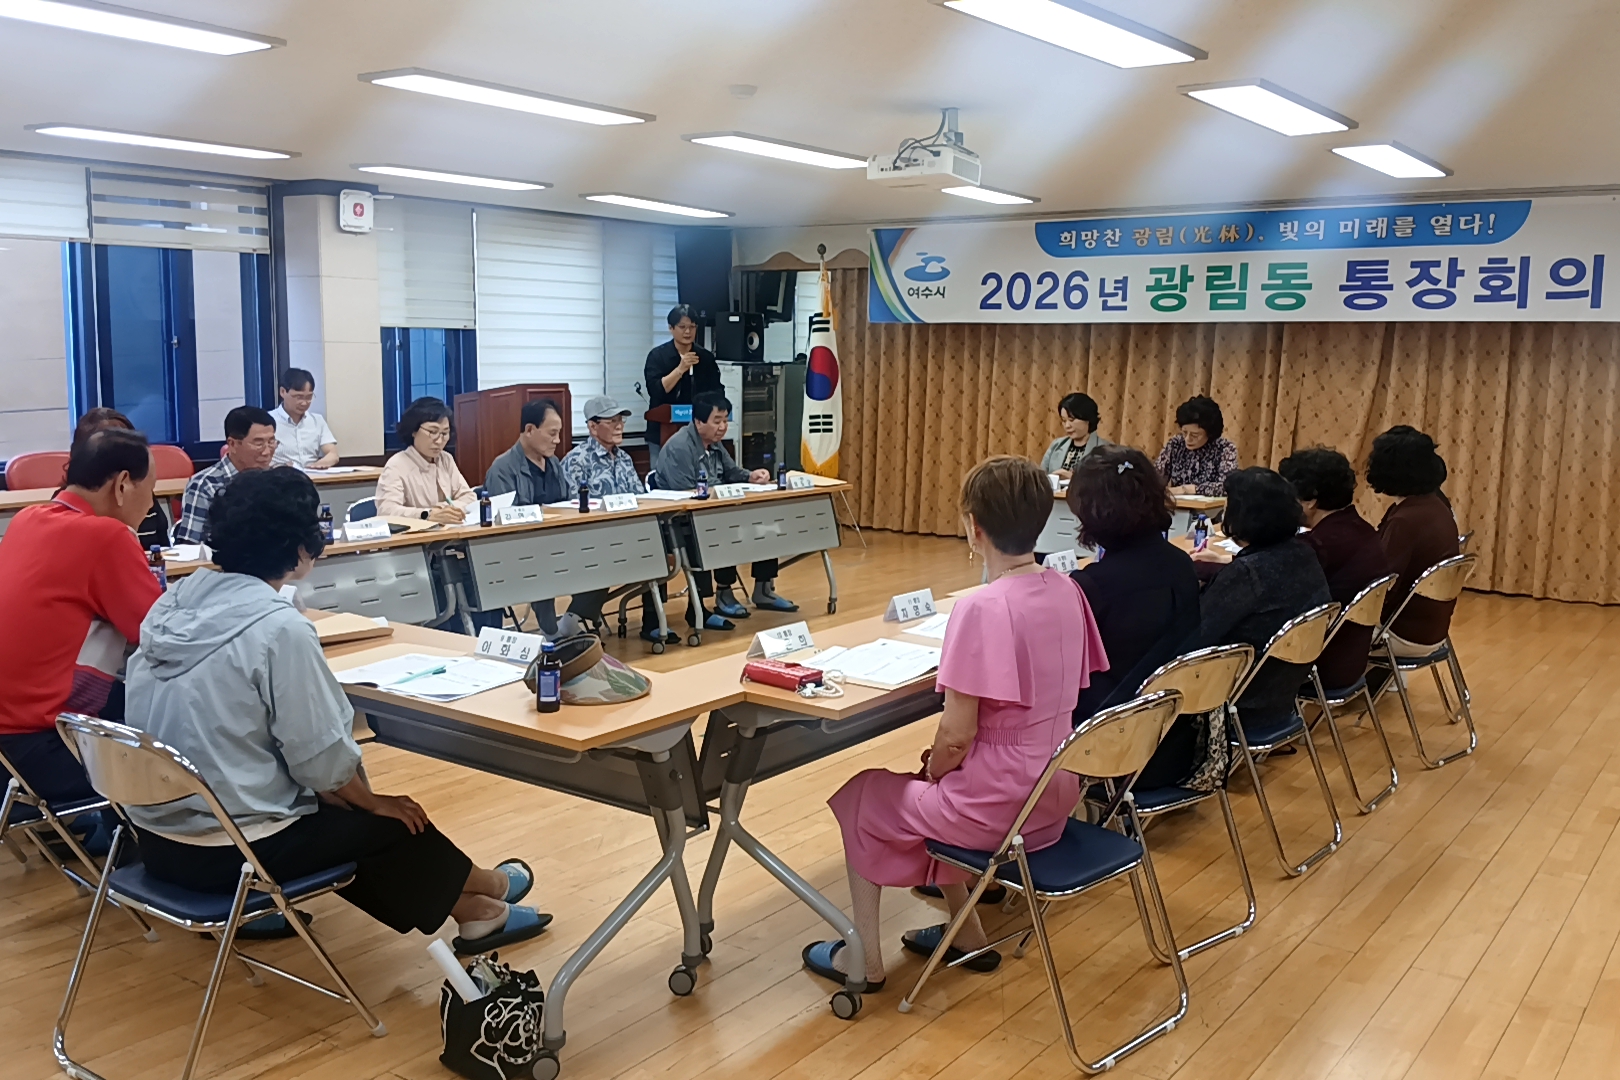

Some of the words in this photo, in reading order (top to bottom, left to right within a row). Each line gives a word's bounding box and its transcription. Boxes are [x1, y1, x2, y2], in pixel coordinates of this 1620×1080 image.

[1059, 228, 1122, 249] 희망찬
[1279, 220, 1325, 242] 빛의
[1339, 216, 1416, 240] 미래를
[1430, 213, 1496, 237] 열다!
[907, 285, 946, 299] 여수시
[979, 269, 1129, 312] 2026년
[1145, 263, 1313, 312] 광림동
[1338, 253, 1605, 312] 통장회의
